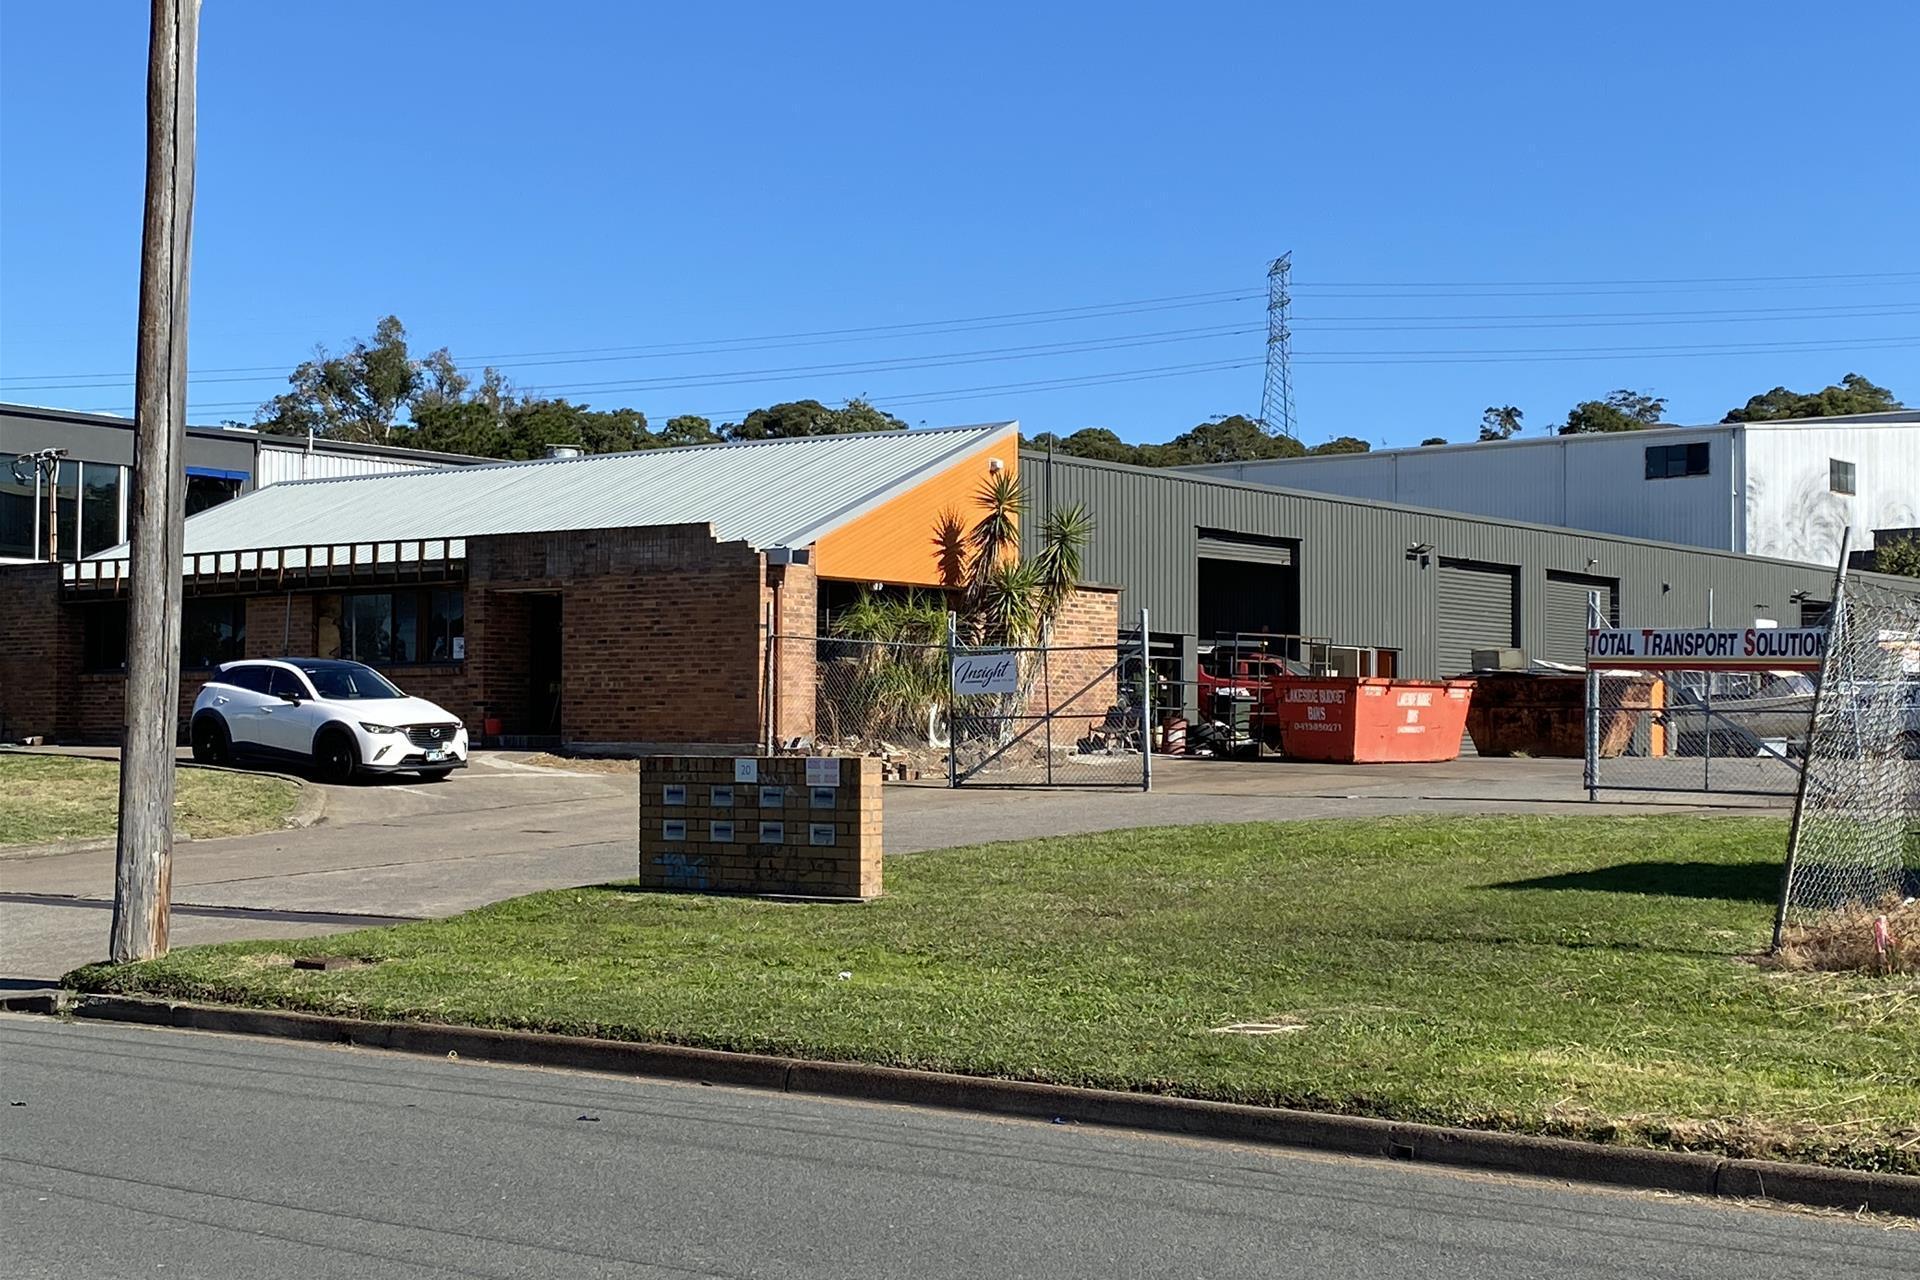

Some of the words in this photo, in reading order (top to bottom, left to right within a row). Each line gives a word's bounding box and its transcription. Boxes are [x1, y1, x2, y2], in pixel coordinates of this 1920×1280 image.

[1589, 629, 1635, 656] TOTAL
[1642, 629, 1738, 656] TRANSPORT
[955, 660, 1013, 688] Insight
[1284, 688, 1319, 704] LAKESIDE
[1319, 689, 1346, 705] BUDGET
[1307, 706, 1326, 721] BINS
[741, 765, 751, 775] 20
